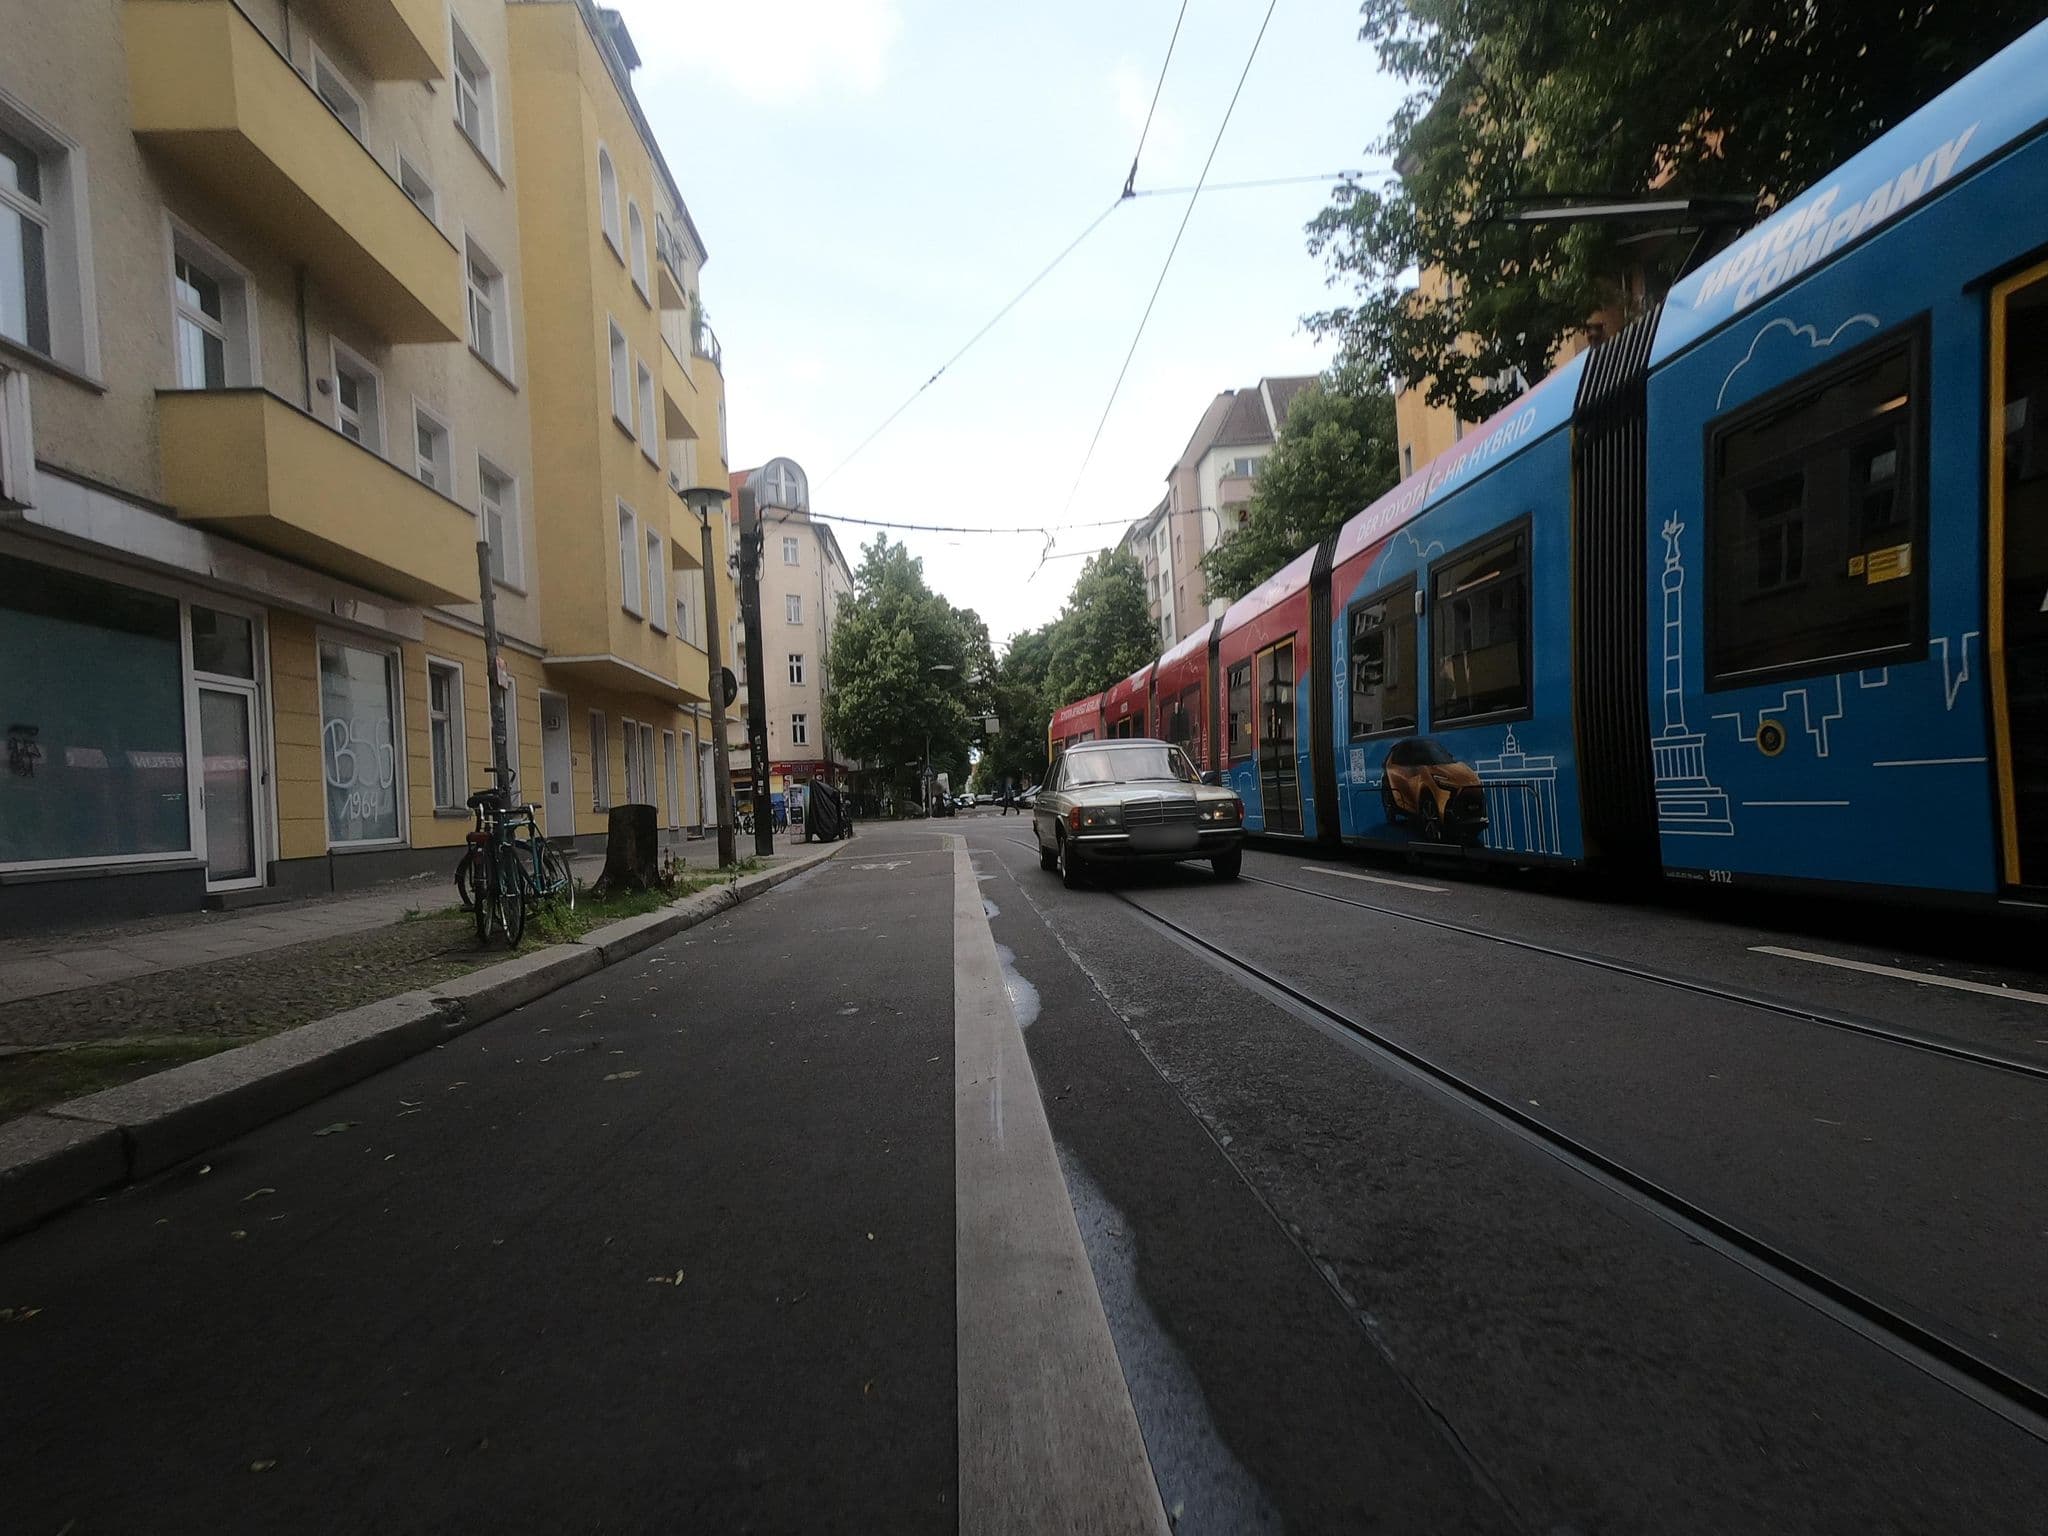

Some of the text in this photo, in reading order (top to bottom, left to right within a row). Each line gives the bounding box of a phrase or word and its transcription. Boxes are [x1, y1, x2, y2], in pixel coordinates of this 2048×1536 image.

[1692, 185, 1840, 311] MOTOR
[1733, 119, 1981, 313] COMPANY
[1357, 518, 1378, 543] DER
[1379, 483, 1427, 526] TOYOTA
[1467, 408, 1537, 469] HYBRID
[340, 791, 378, 822] 1964
[1709, 869, 1732, 883] 9112
